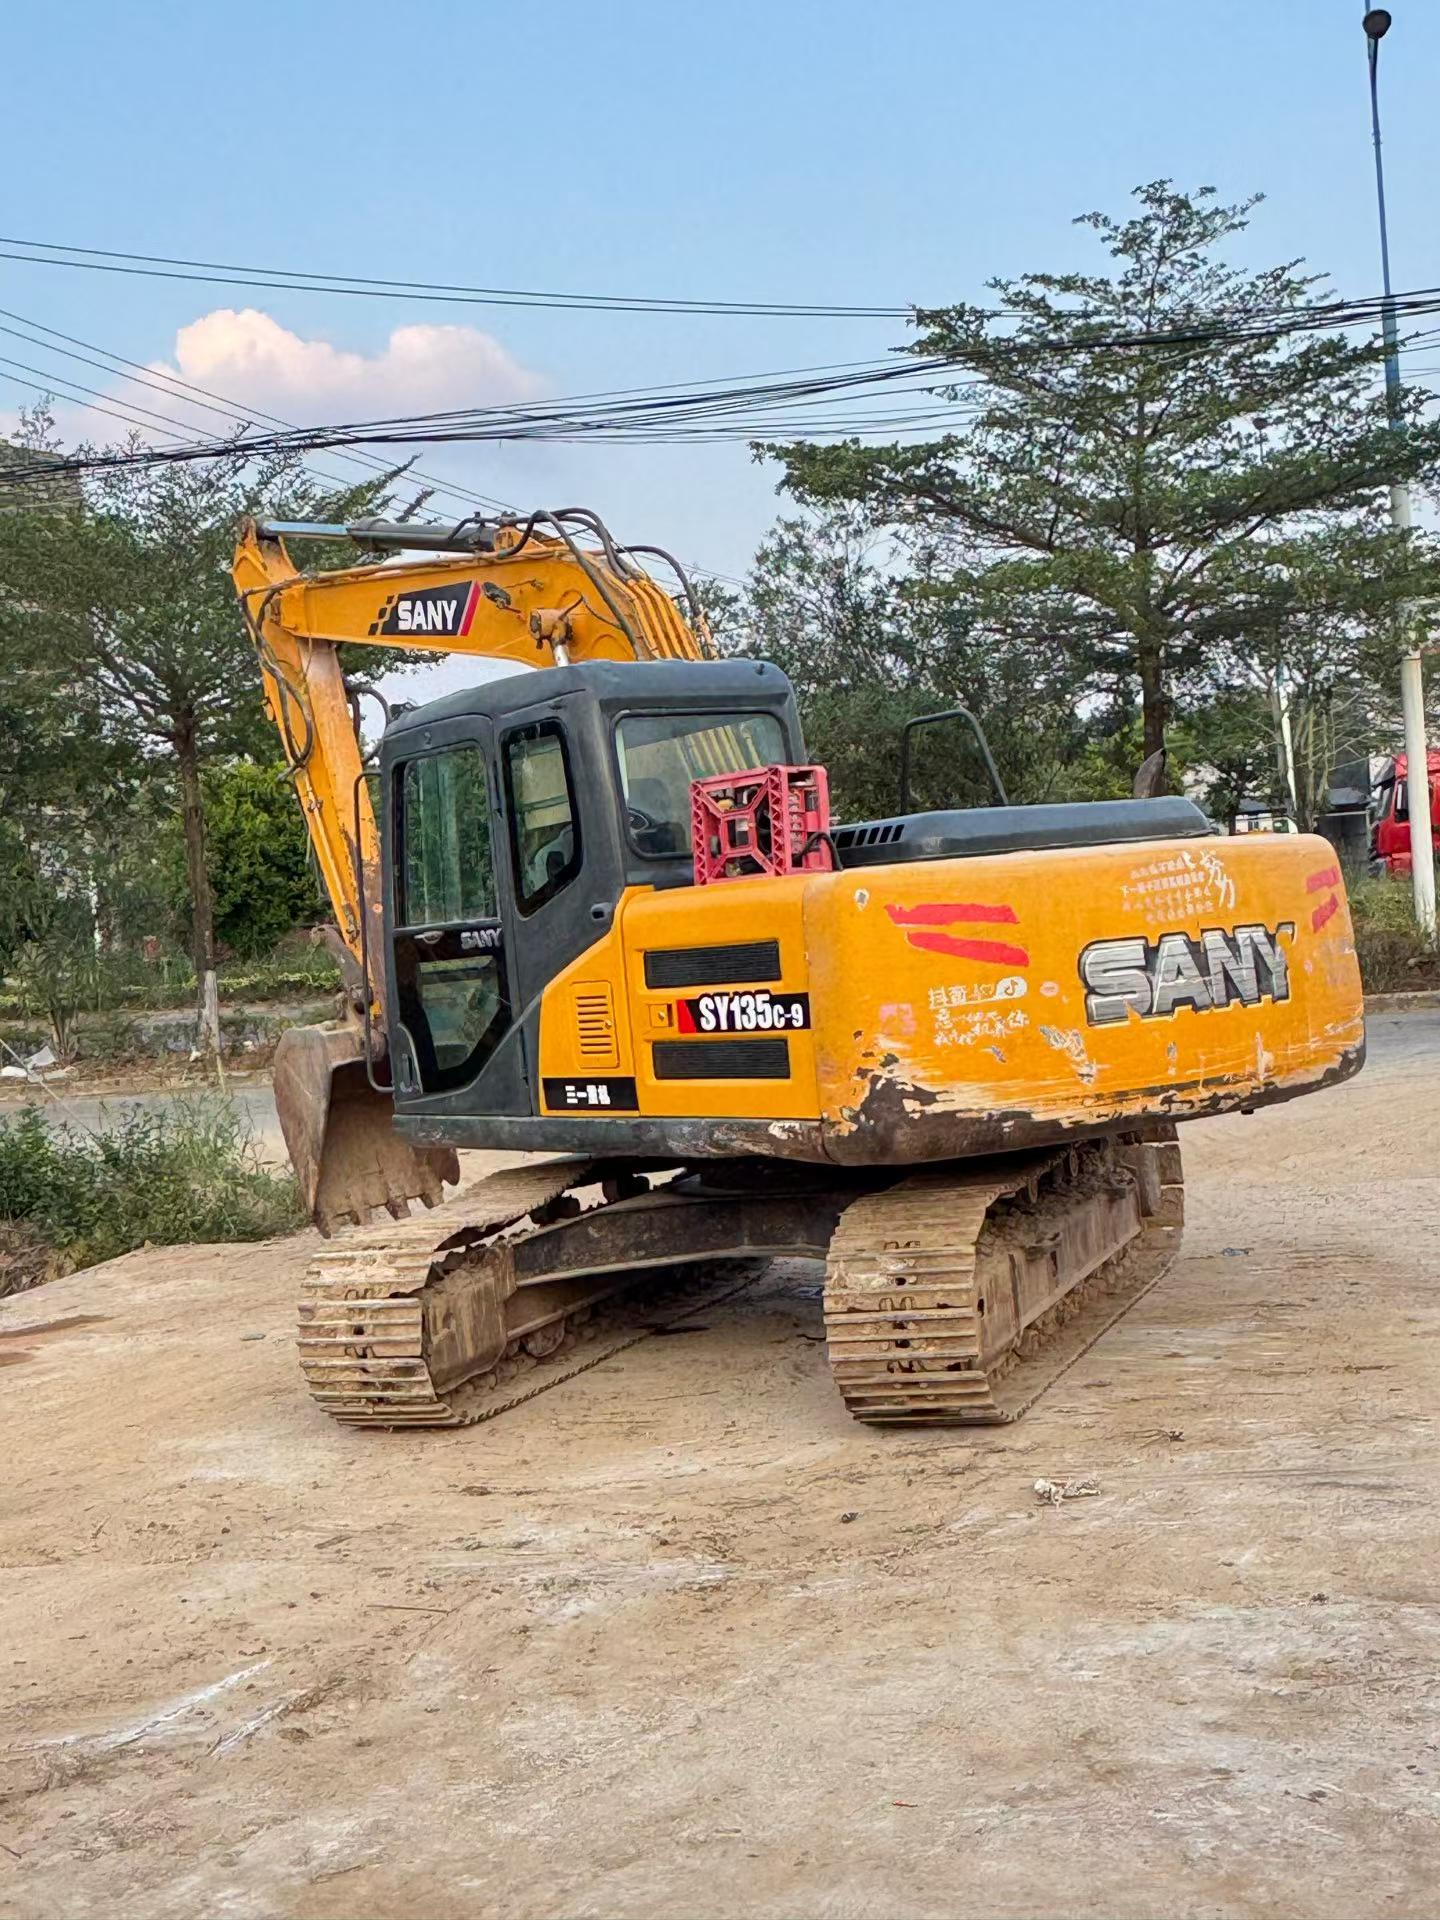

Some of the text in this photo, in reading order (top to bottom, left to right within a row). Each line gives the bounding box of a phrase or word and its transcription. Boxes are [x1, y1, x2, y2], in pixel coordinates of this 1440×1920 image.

[398, 600, 457, 630] SANY
[1079, 922, 1294, 1025] SANY
[565, 1085, 611, 1105] 三一
